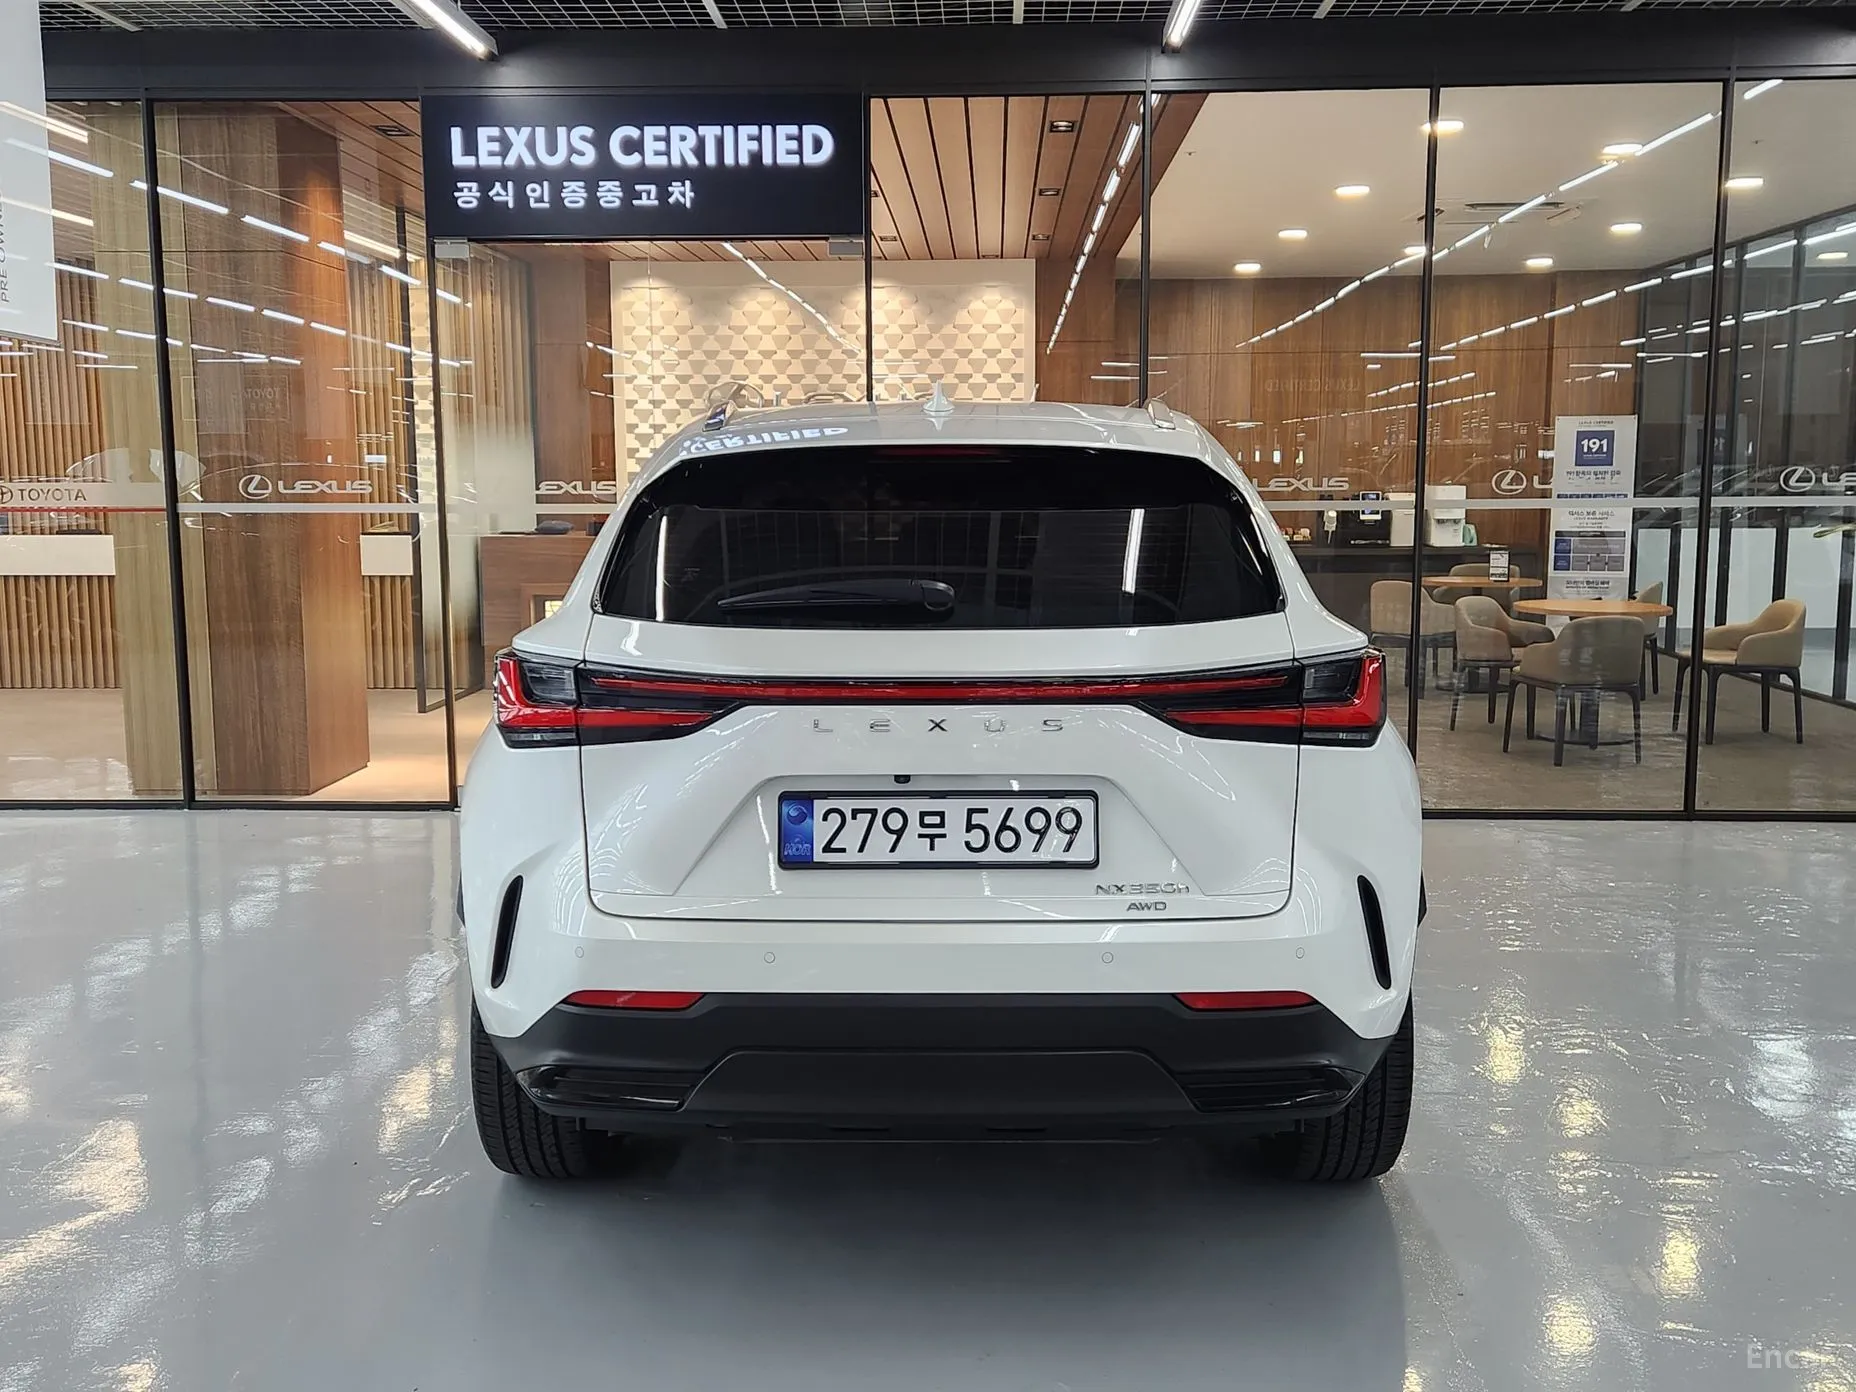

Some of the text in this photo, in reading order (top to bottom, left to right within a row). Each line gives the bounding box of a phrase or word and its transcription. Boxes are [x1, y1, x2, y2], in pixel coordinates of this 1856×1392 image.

[450, 125, 835, 168] LEXUS CERTIFIED
[453, 180, 696, 209] 공식인증중고차
[1581, 438, 1608, 453] 191
[278, 480, 373, 494] LEXUS
[535, 480, 618, 495] EXUS
[1252, 477, 1350, 492] LEXUS
[18, 488, 87, 502] TOYOTA
[812, 718, 1064, 733] LEXUS
[821, 806, 1084, 854] 279무 5699
[1126, 901, 1167, 912] AWD
